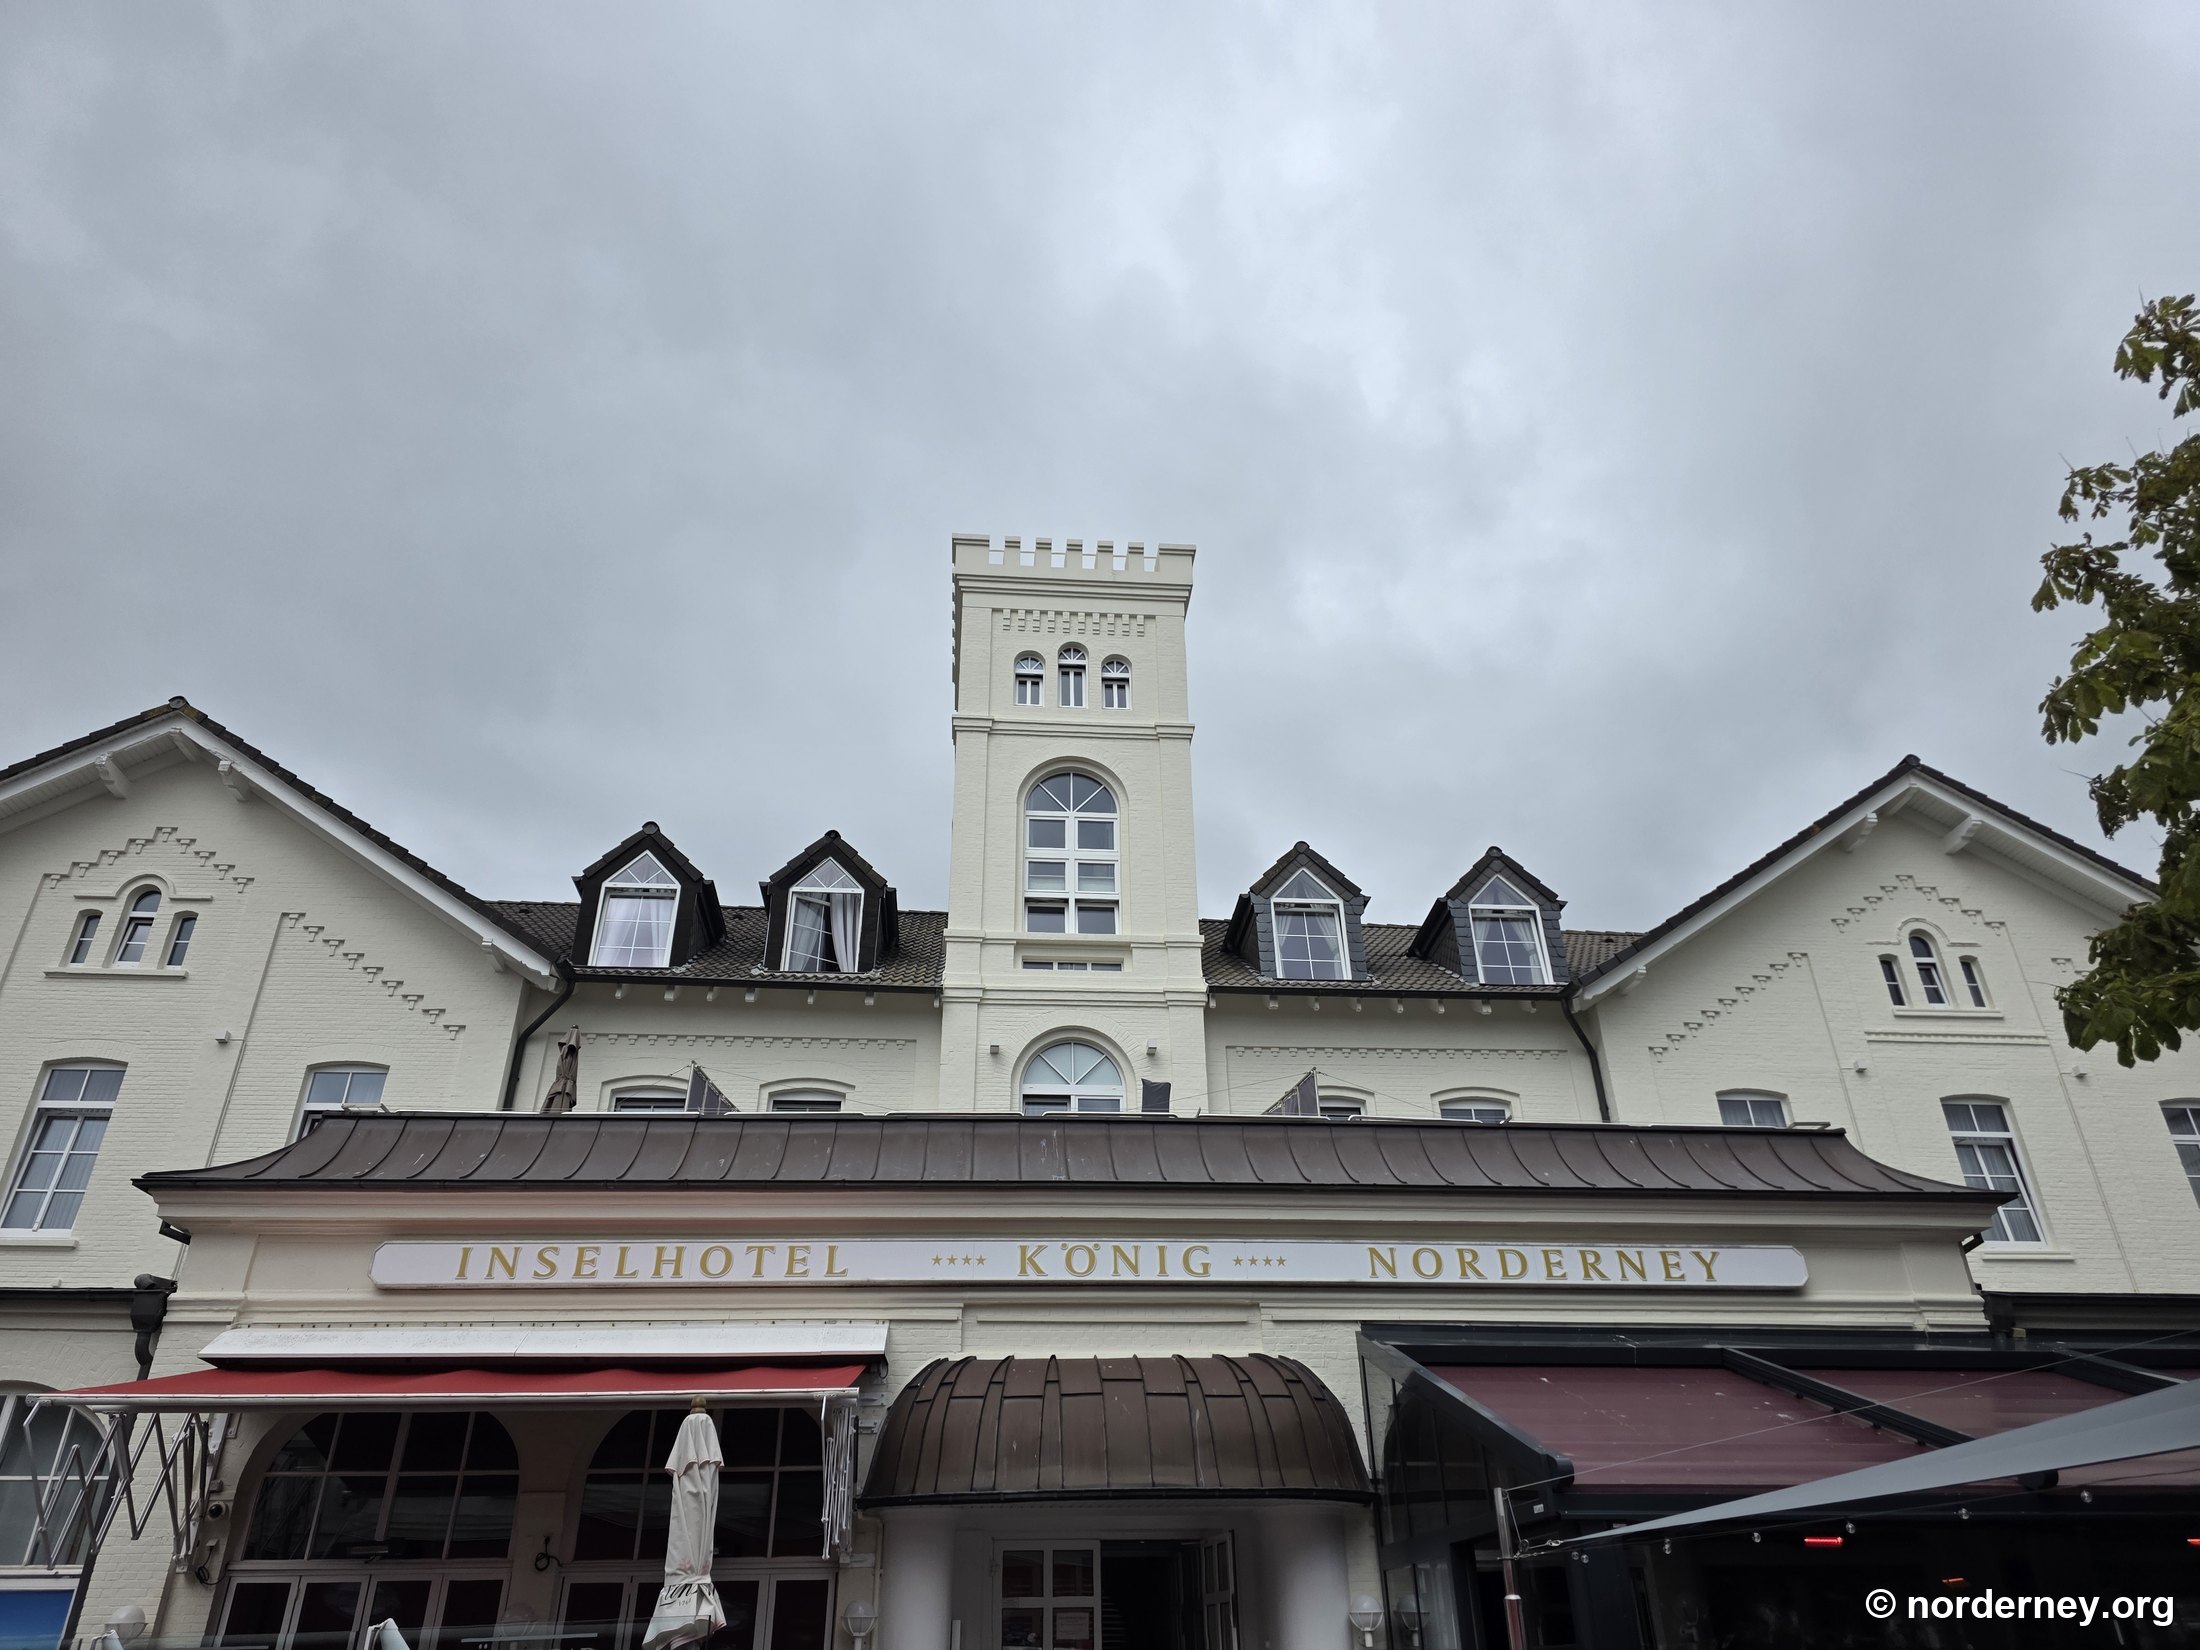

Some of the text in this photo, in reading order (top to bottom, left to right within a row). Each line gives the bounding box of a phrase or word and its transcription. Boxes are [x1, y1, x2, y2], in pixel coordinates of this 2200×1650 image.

[456, 1239, 1721, 1286] INSELHOTEL KÖNIG NORDERNEY
